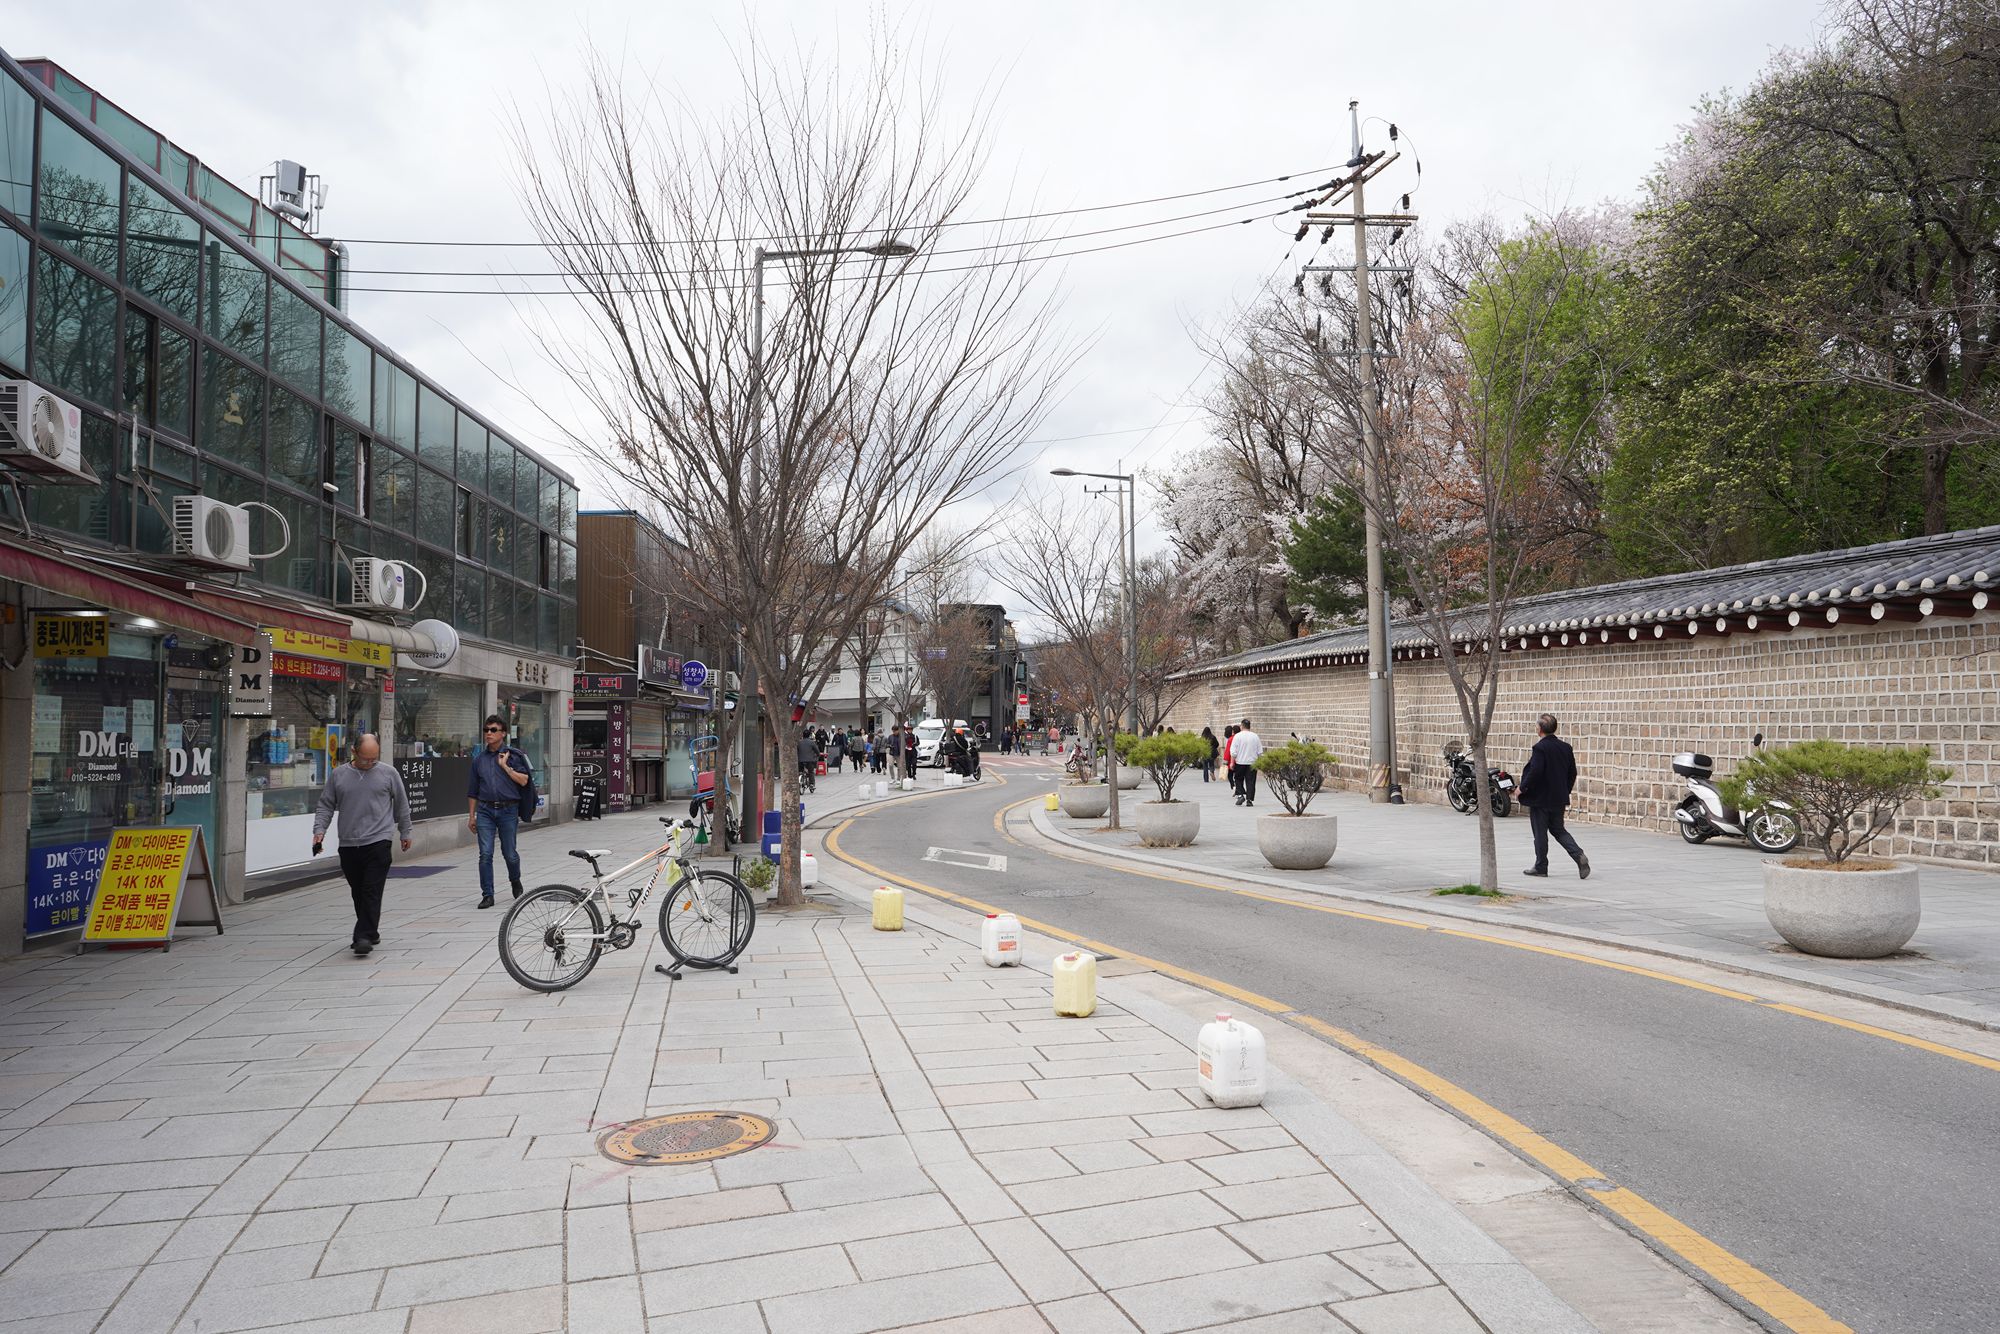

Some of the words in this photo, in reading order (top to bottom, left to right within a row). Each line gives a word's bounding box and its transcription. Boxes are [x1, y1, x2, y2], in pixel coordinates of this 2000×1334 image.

[37, 620, 105, 647] 종로시계천국
[683, 668, 705, 677] 성창사
[78, 731, 118, 757] DM
[119, 742, 139, 758] 디엠
[88, 763, 117, 771] Diamond
[71, 773, 121, 782] 010-5224-4019
[165, 782, 211, 796] Diamond
[609, 793, 624, 801] 커피
[115, 836, 132, 850] DM
[142, 834, 187, 850] 다이아몬드
[46, 852, 68, 869] DM
[117, 875, 139, 889] 14K
[144, 874, 166, 889] 18K
[102, 894, 141, 911] 은제품
[144, 893, 170, 910] 백금
[51, 906, 80, 925] 금이빨
